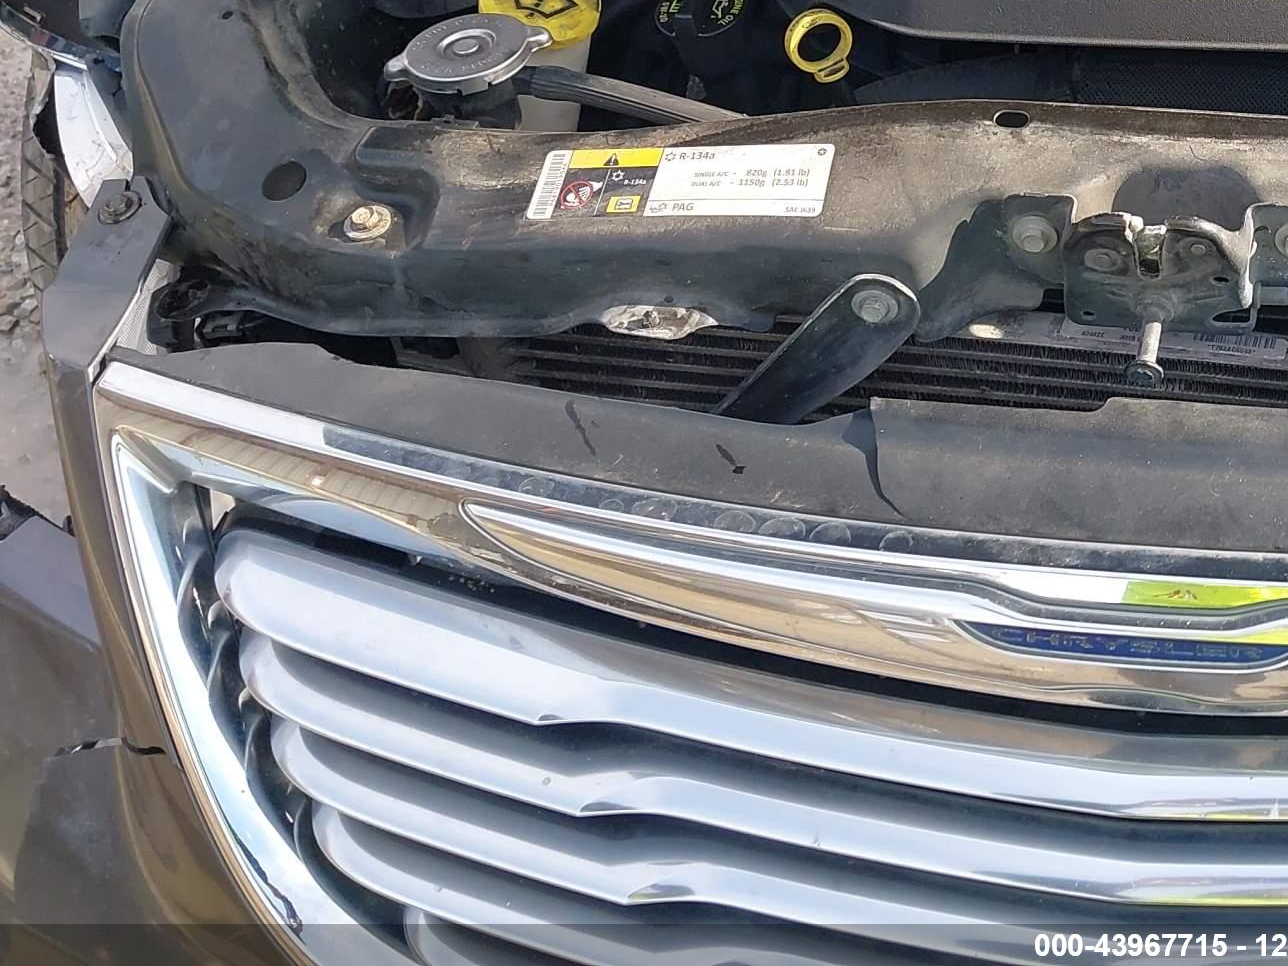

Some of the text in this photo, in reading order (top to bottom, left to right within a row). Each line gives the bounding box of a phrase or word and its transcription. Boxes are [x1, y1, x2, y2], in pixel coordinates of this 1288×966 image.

[717, 14, 735, 26] OIL
[678, 151, 716, 161] R-134a
[745, 169, 768, 178] 820g
[773, 168, 796, 178] (1.81
[797, 168, 811, 177] lb)
[738, 178, 766, 188] 1150g
[771, 178, 795, 187] (2.53
[796, 178, 809, 187] lb)
[671, 202, 695, 212] PAG
[784, 206, 800, 214] SAE
[991, 628, 1263, 659] CHRYSLER
